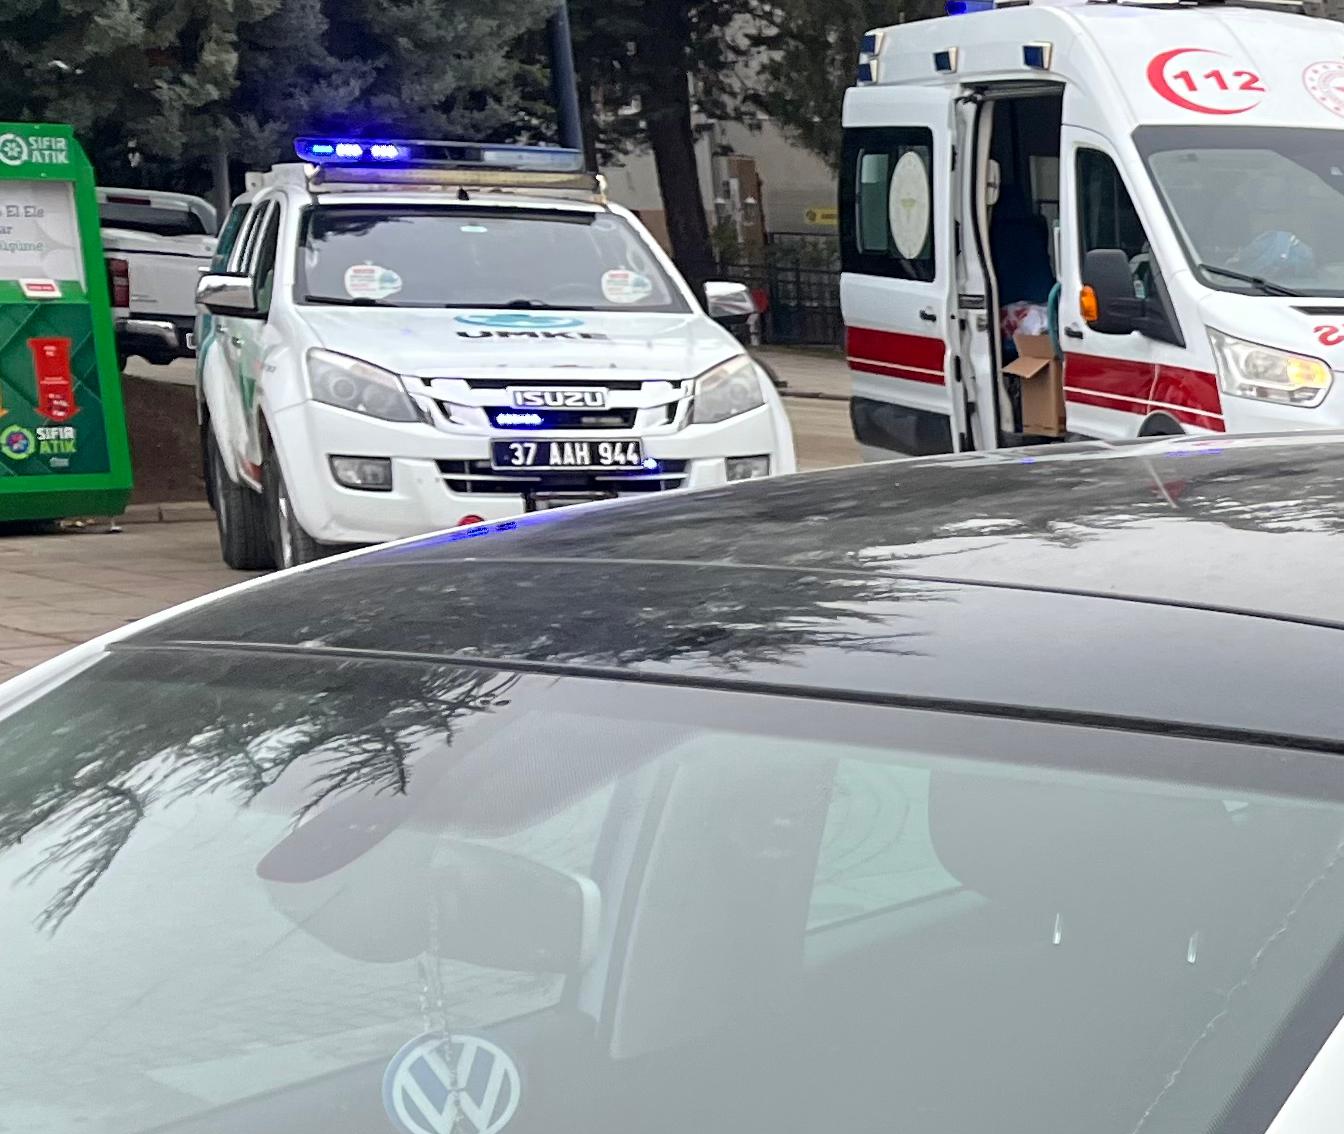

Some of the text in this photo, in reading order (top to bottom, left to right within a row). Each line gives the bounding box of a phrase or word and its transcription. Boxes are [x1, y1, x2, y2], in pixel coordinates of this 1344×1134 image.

[1172, 69, 1266, 93] 112
[28, 137, 67, 150] SIFIR
[31, 150, 70, 164] ATIK
[456, 330, 609, 341] UMKE
[514, 391, 603, 408] ISUZU
[36, 427, 75, 441] SIFIR
[39, 440, 77, 454] ATIK
[509, 442, 640, 466] 37 AAH 944
